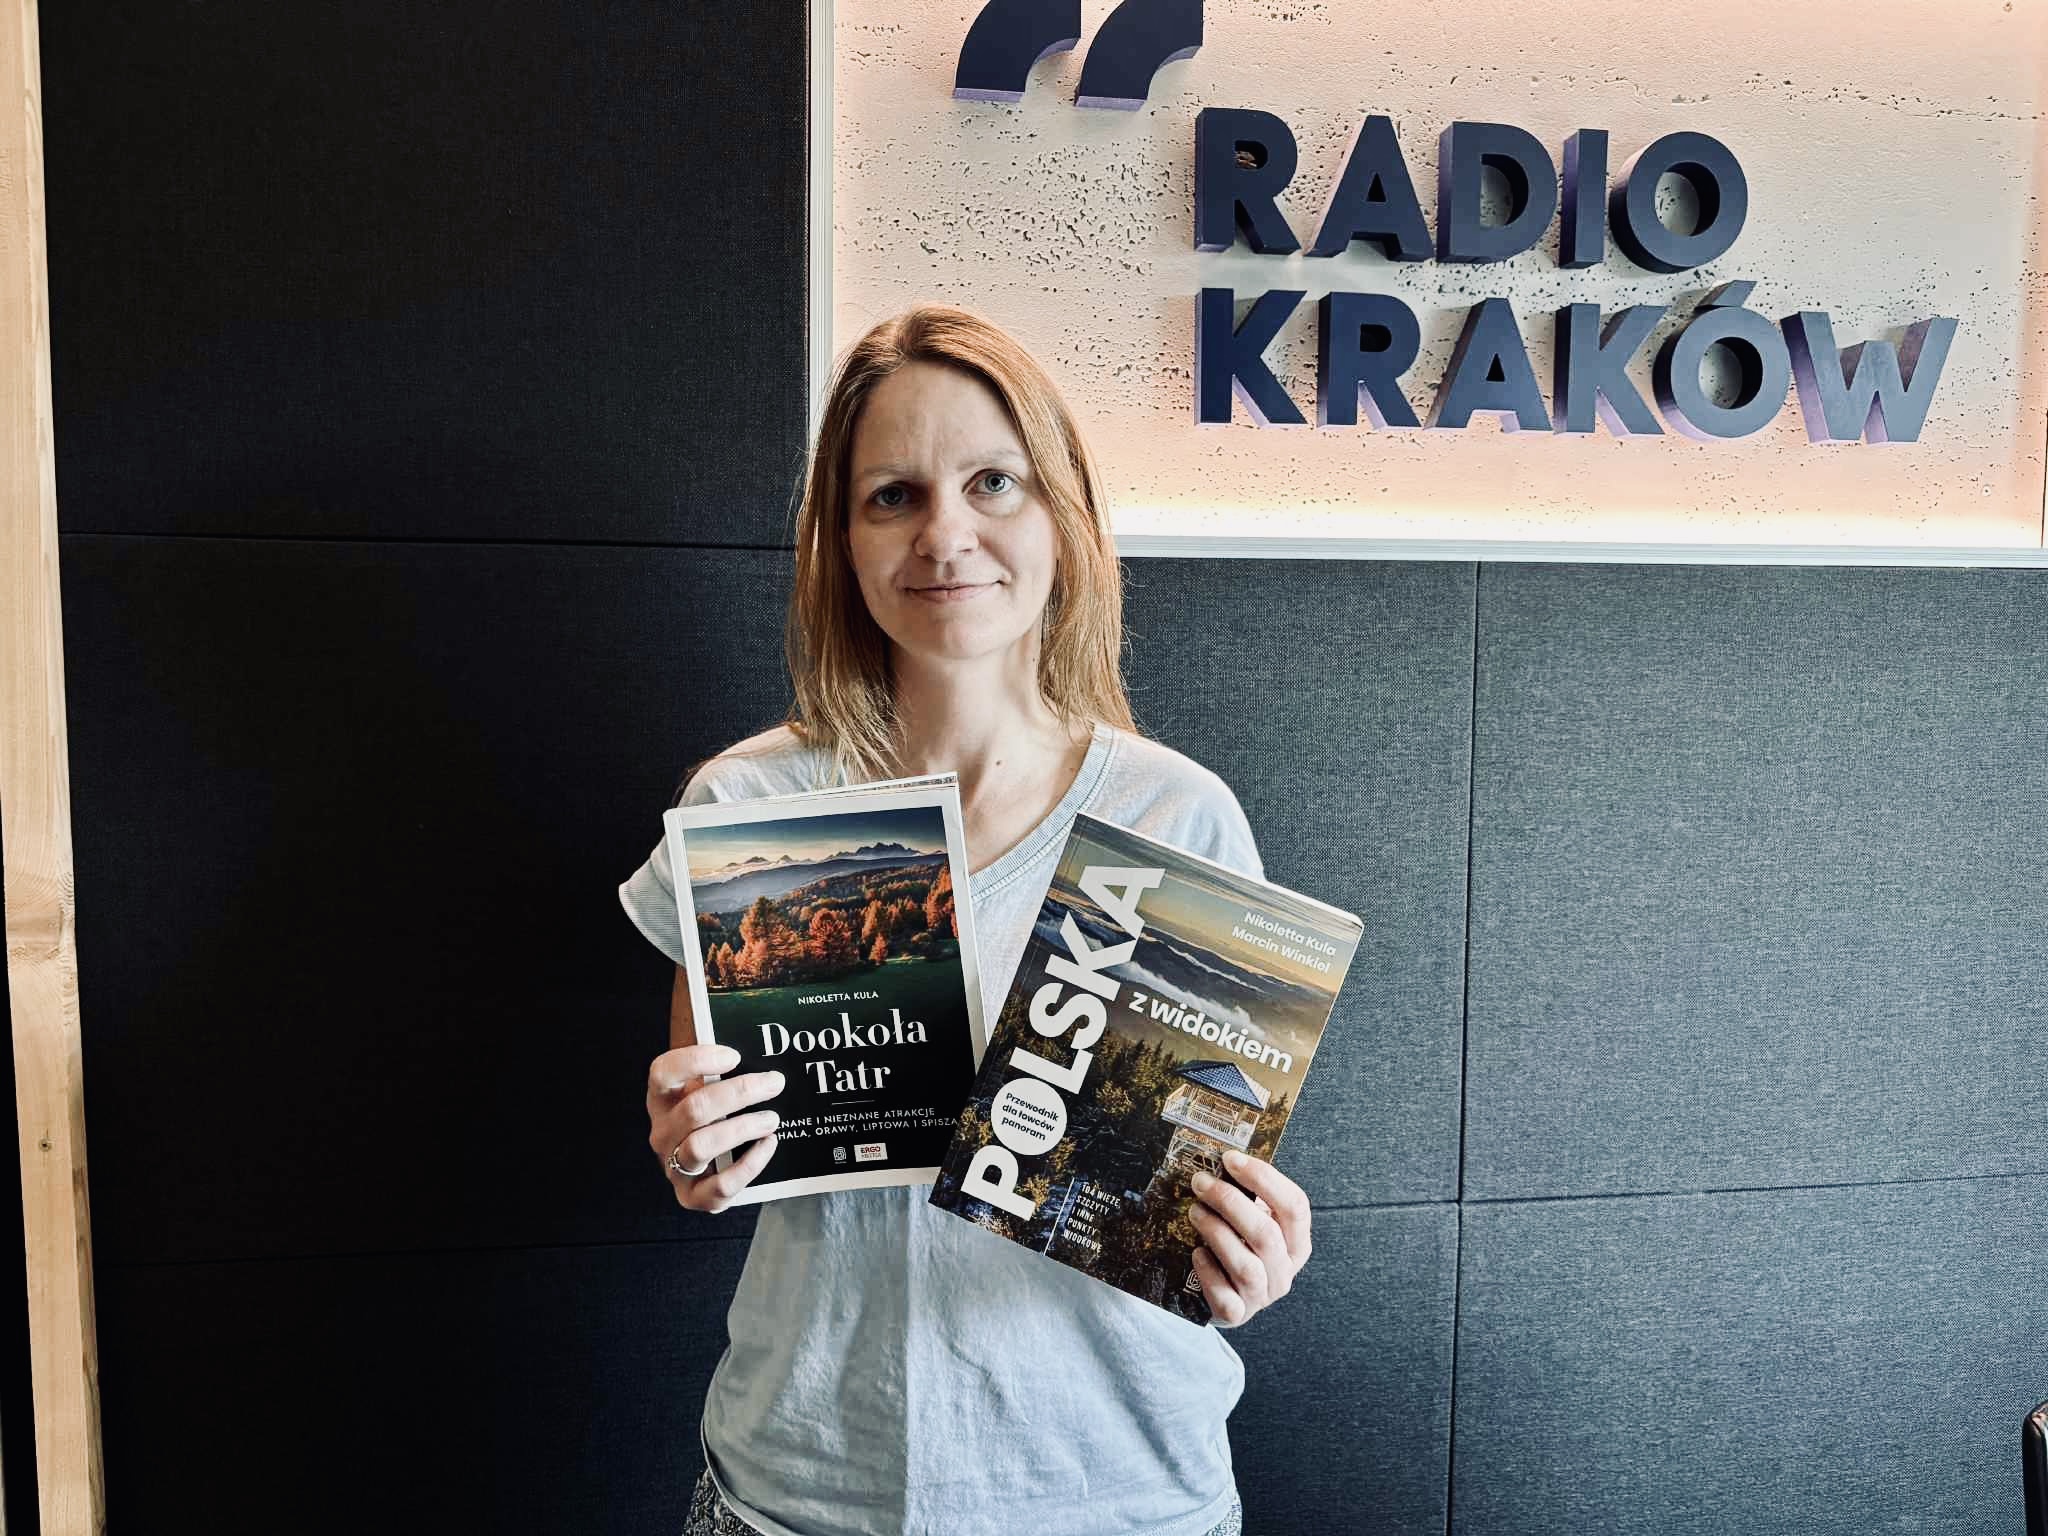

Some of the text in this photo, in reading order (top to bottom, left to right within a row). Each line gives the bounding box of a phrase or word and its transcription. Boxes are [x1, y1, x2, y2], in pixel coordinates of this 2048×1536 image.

[1195, 108, 1749, 274] RADIO
[1195, 280, 1959, 445] KRAKÓW
[1232, 926, 1279, 953] Marcin
[1244, 911, 1337, 956] Nikoletta Kula
[798, 991, 879, 1005] NIKOLETTA KULA
[756, 1008, 928, 1057] Dookoła
[960, 866, 1166, 1222] POLSKA
[1128, 991, 1293, 1073] z widokiem
[805, 1060, 892, 1094] Tatr
[778, 1107, 935, 1129] NANE I NIEZNANE ATRAKCJE
[1002, 1104, 1018, 1115] dla
[1006, 1092, 1059, 1121] Przewodnik
[777, 1117, 958, 1141] HALA, ORAWY, LIPTOWA I SPISZA
[1001, 1117, 1046, 1141] panoram
[1076, 1195, 1110, 1215] SZCZYTY
[1077, 1208, 1095, 1222] INNE
[1067, 1217, 1097, 1236] PUNKTY
